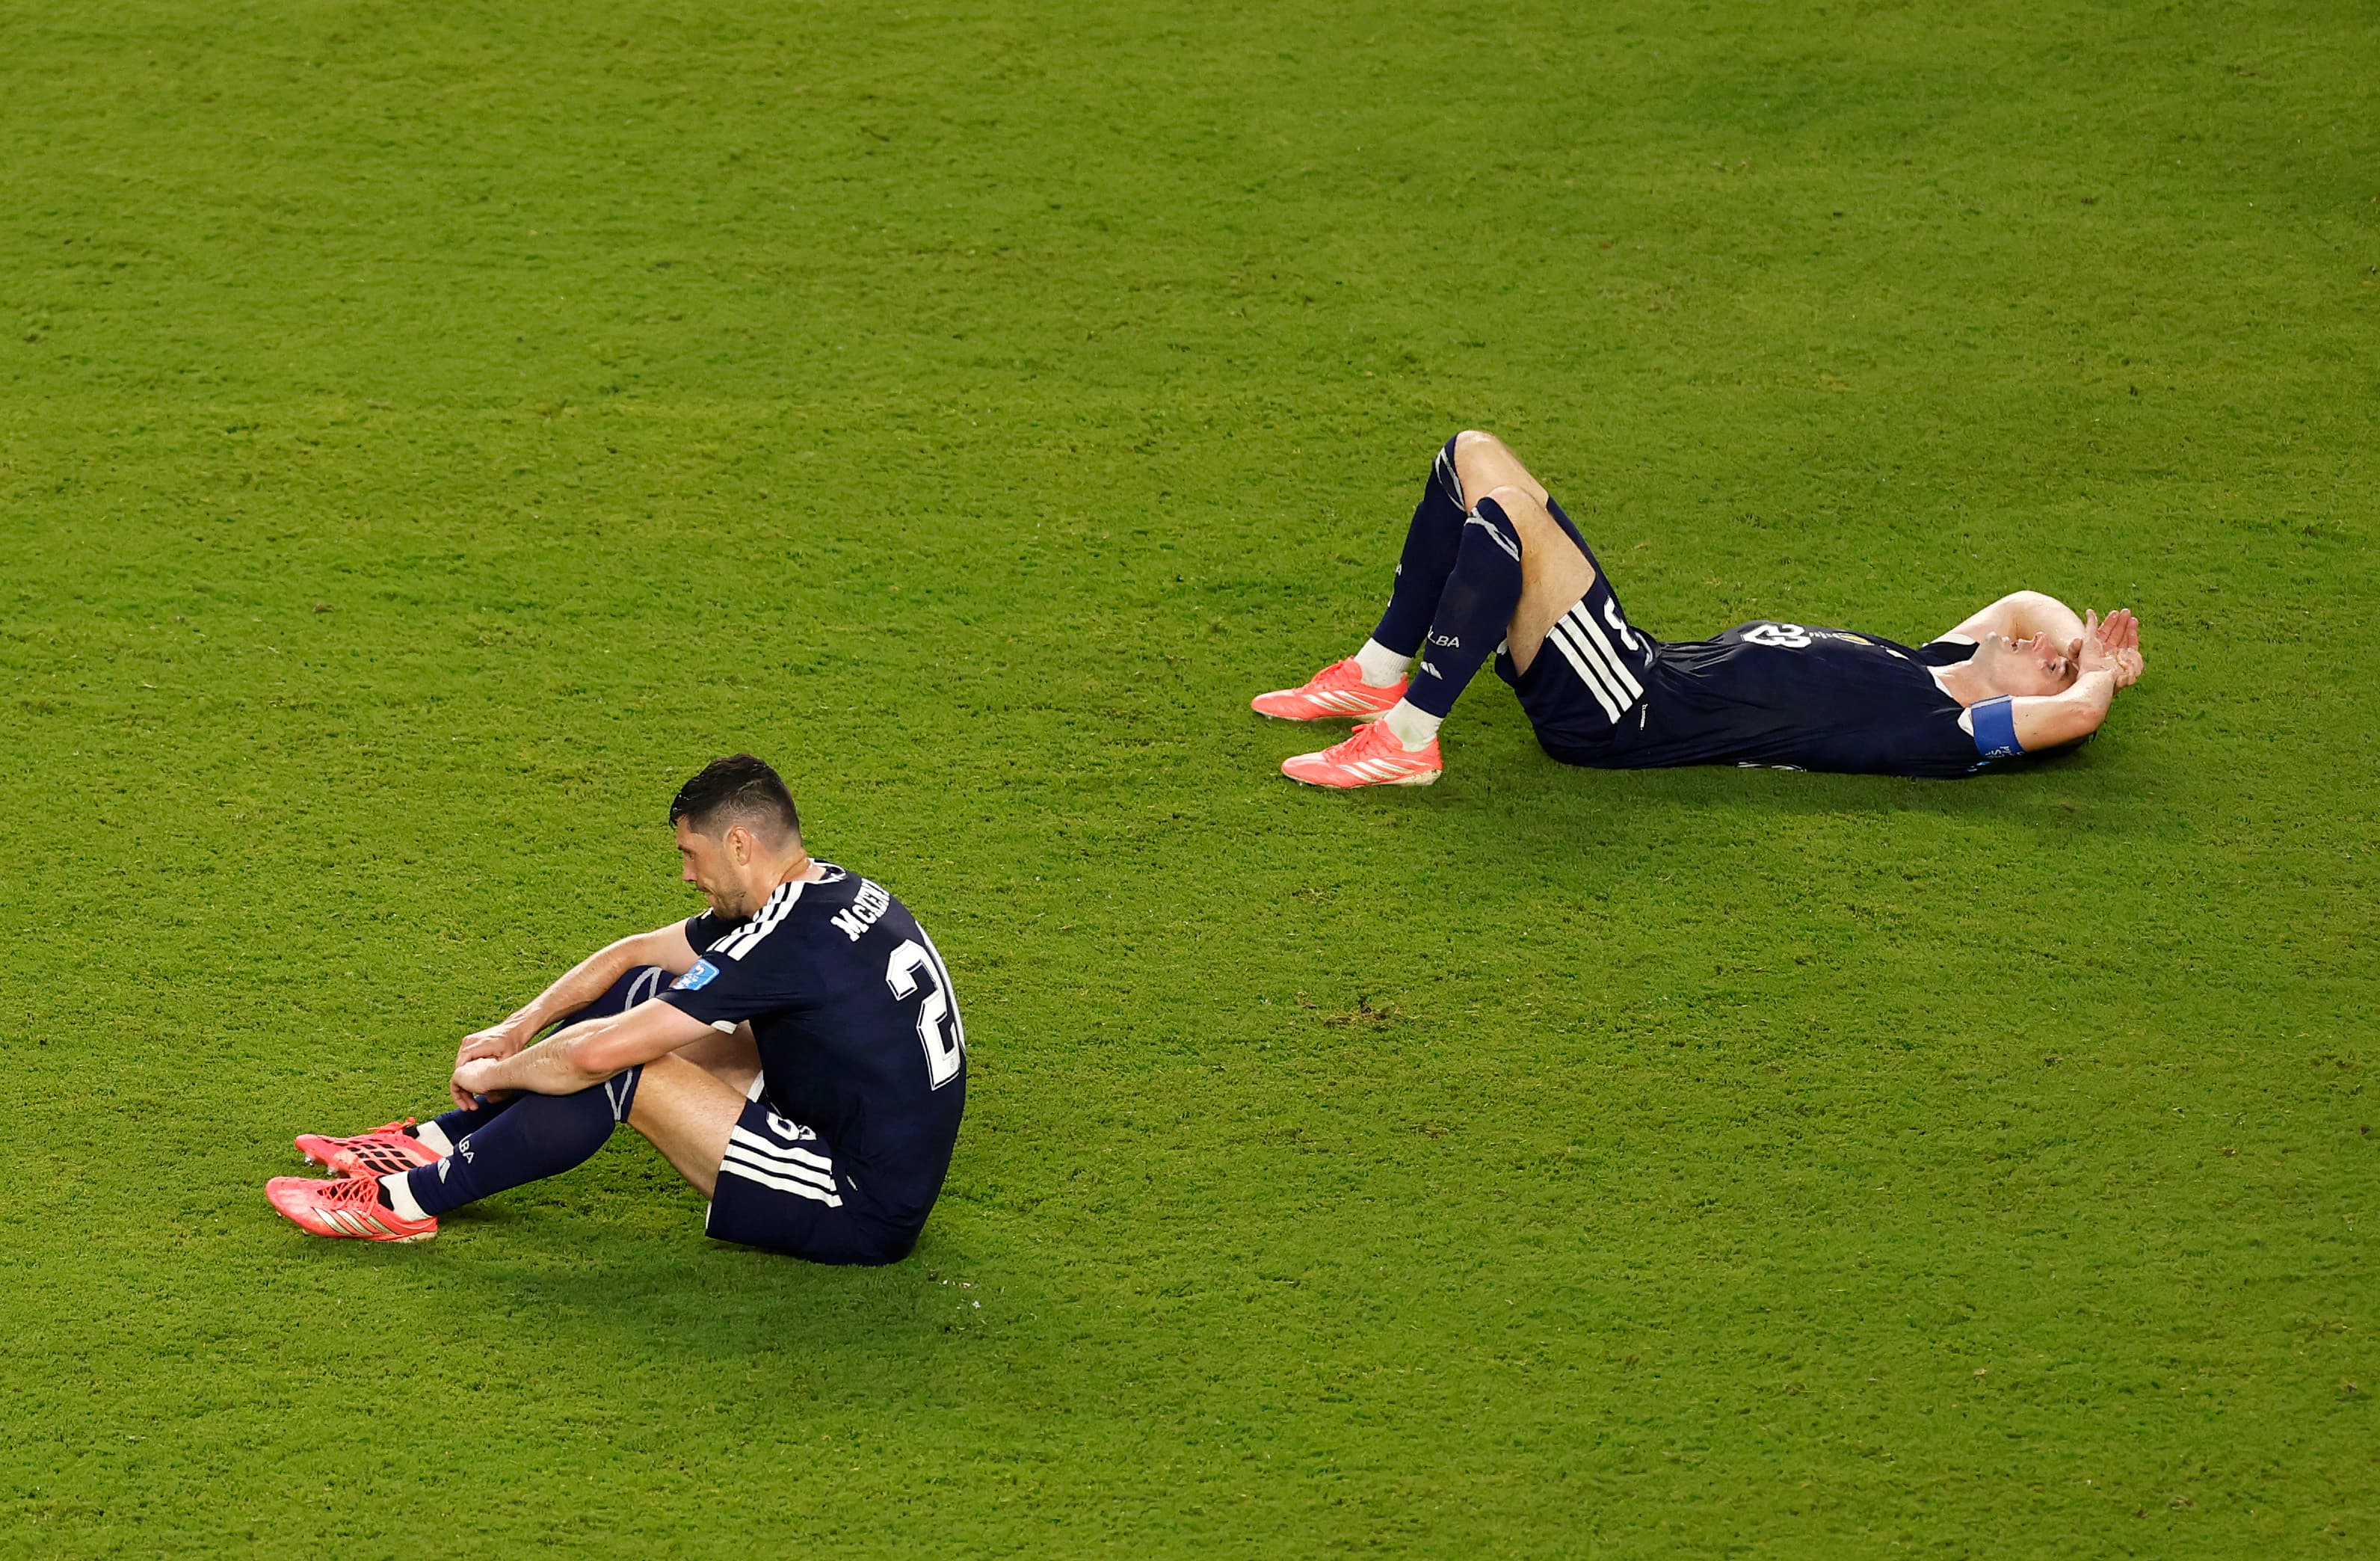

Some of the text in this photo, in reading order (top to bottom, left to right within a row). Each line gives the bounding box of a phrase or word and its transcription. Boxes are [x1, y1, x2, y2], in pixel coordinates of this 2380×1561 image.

[1741, 624, 1811, 647] 23
[830, 877, 890, 942] McKEN
[886, 920, 967, 1092] 2
